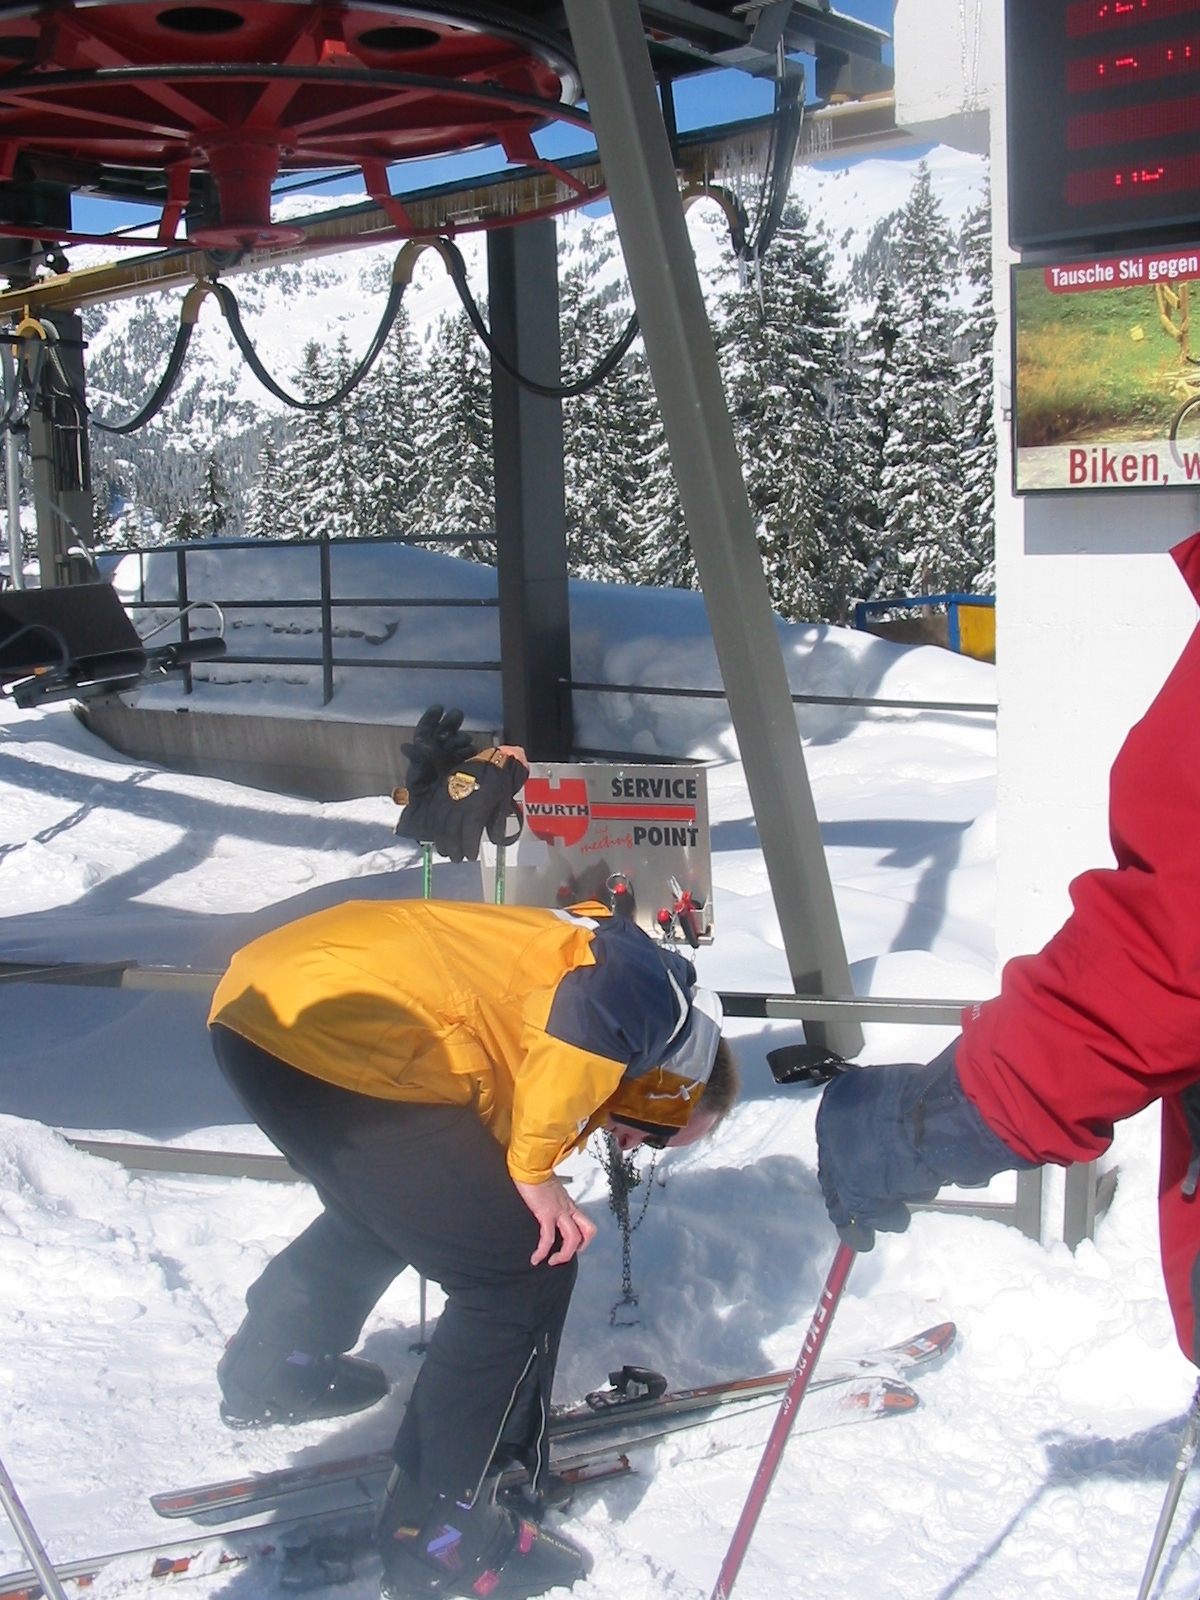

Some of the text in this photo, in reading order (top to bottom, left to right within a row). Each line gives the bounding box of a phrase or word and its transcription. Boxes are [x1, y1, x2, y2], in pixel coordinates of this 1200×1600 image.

[1051, 256, 1198, 287] Tausche Ski gegen
[1069, 447, 1169, 487] Biken,
[611, 777, 697, 799] SERVICE
[633, 826, 699, 847] POINT
